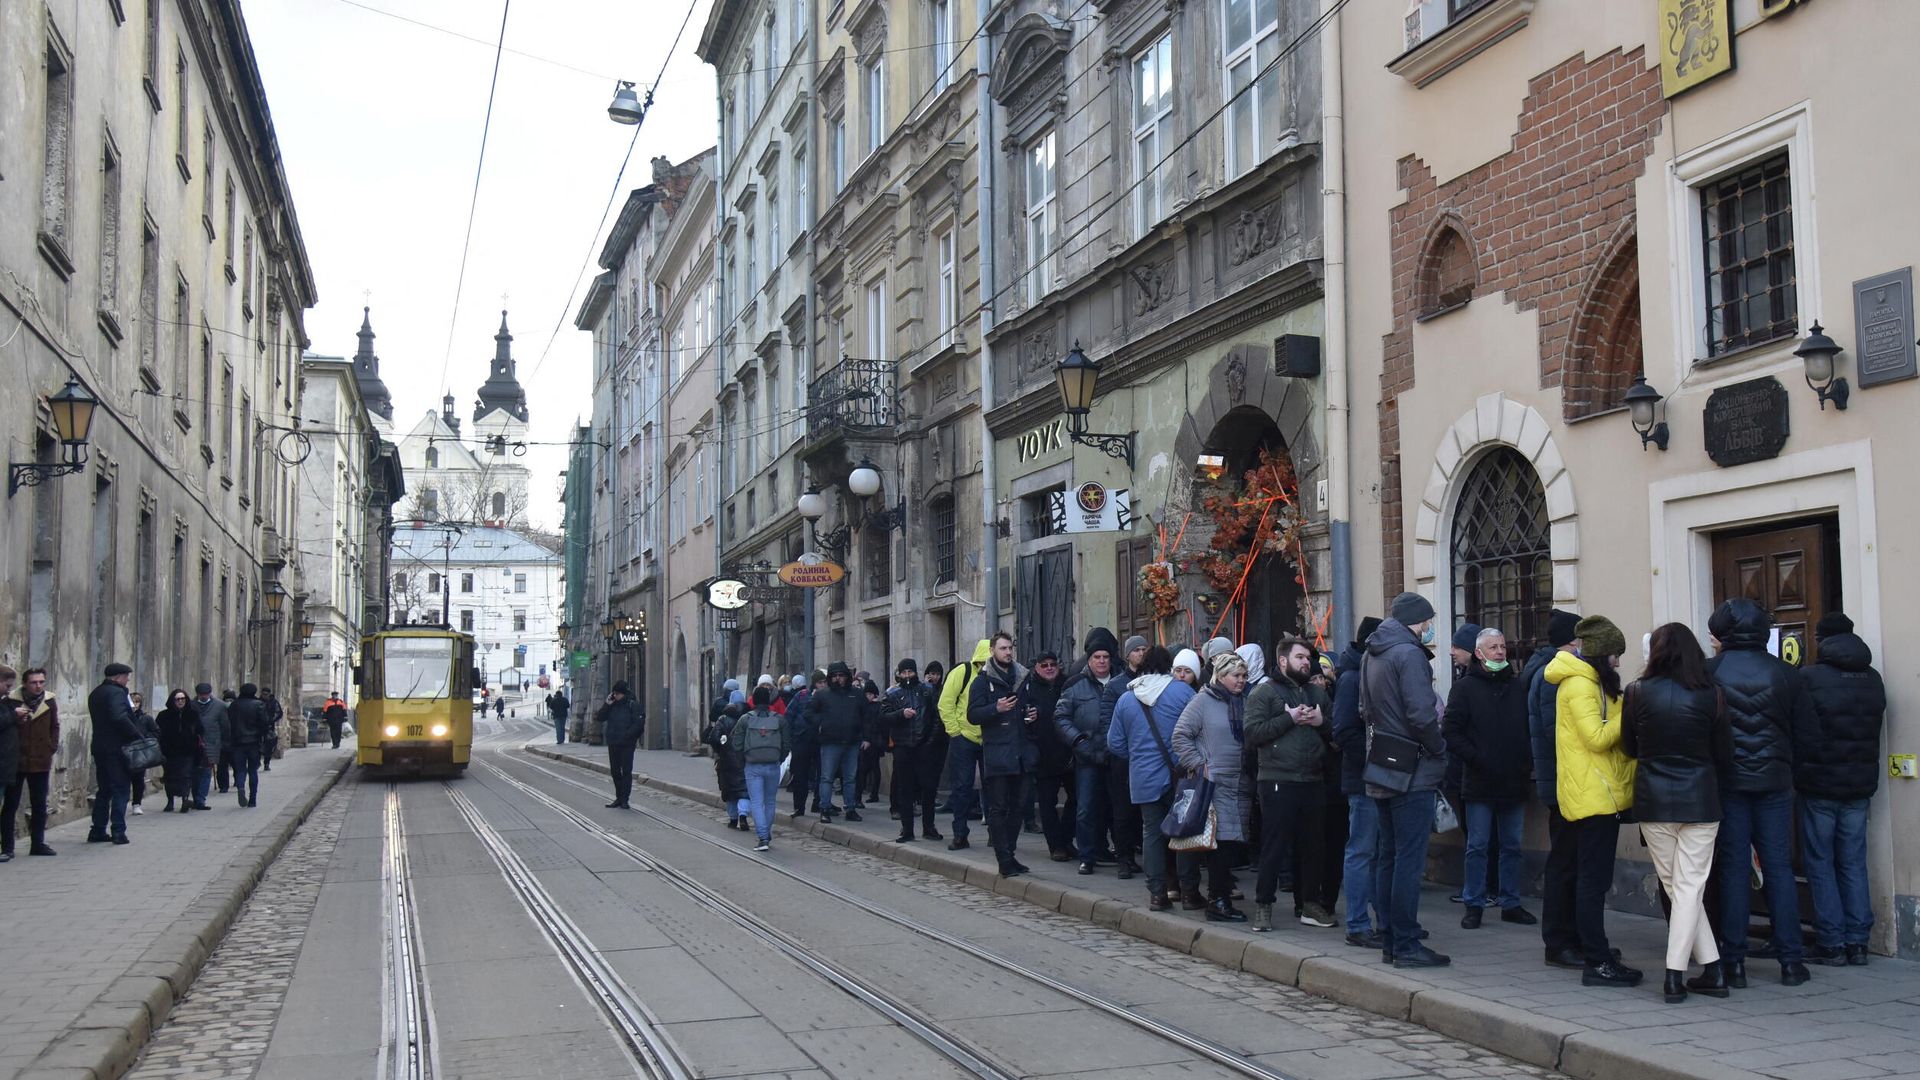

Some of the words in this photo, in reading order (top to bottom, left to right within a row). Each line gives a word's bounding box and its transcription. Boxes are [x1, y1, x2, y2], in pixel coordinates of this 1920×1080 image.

[1017, 419, 1063, 463] VOYK
[1319, 485, 1325, 506] 4
[793, 566, 830, 574] РОДИННА
[790, 575, 833, 583] КОВБАСКА
[406, 725, 423, 736] 1072
